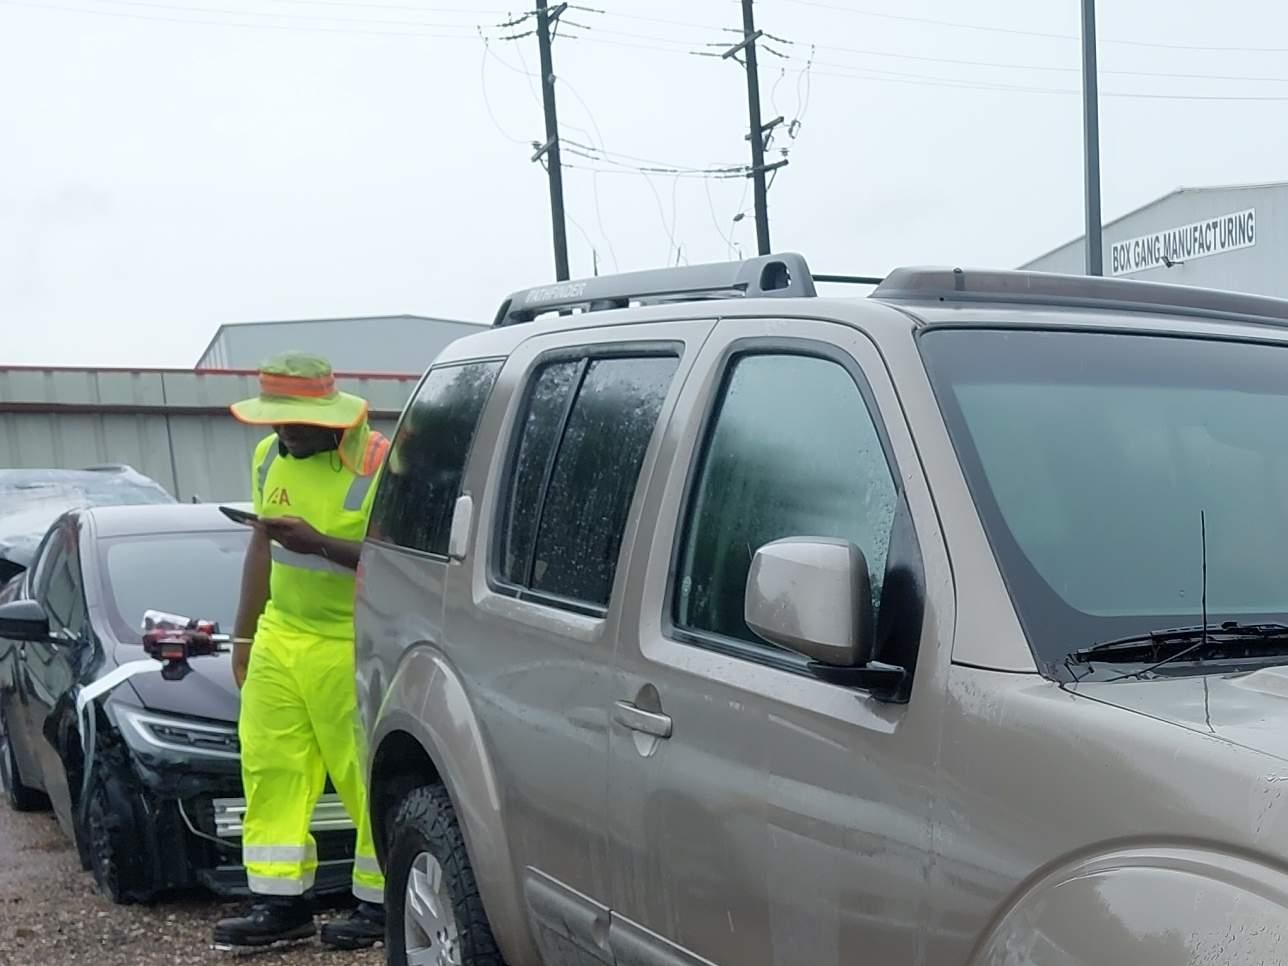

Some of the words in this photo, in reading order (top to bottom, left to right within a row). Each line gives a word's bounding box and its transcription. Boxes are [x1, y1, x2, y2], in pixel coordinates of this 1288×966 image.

[1112, 241, 1131, 273] BOX
[1133, 235, 1160, 268] GANG
[1163, 212, 1254, 260] MANUFACTURING
